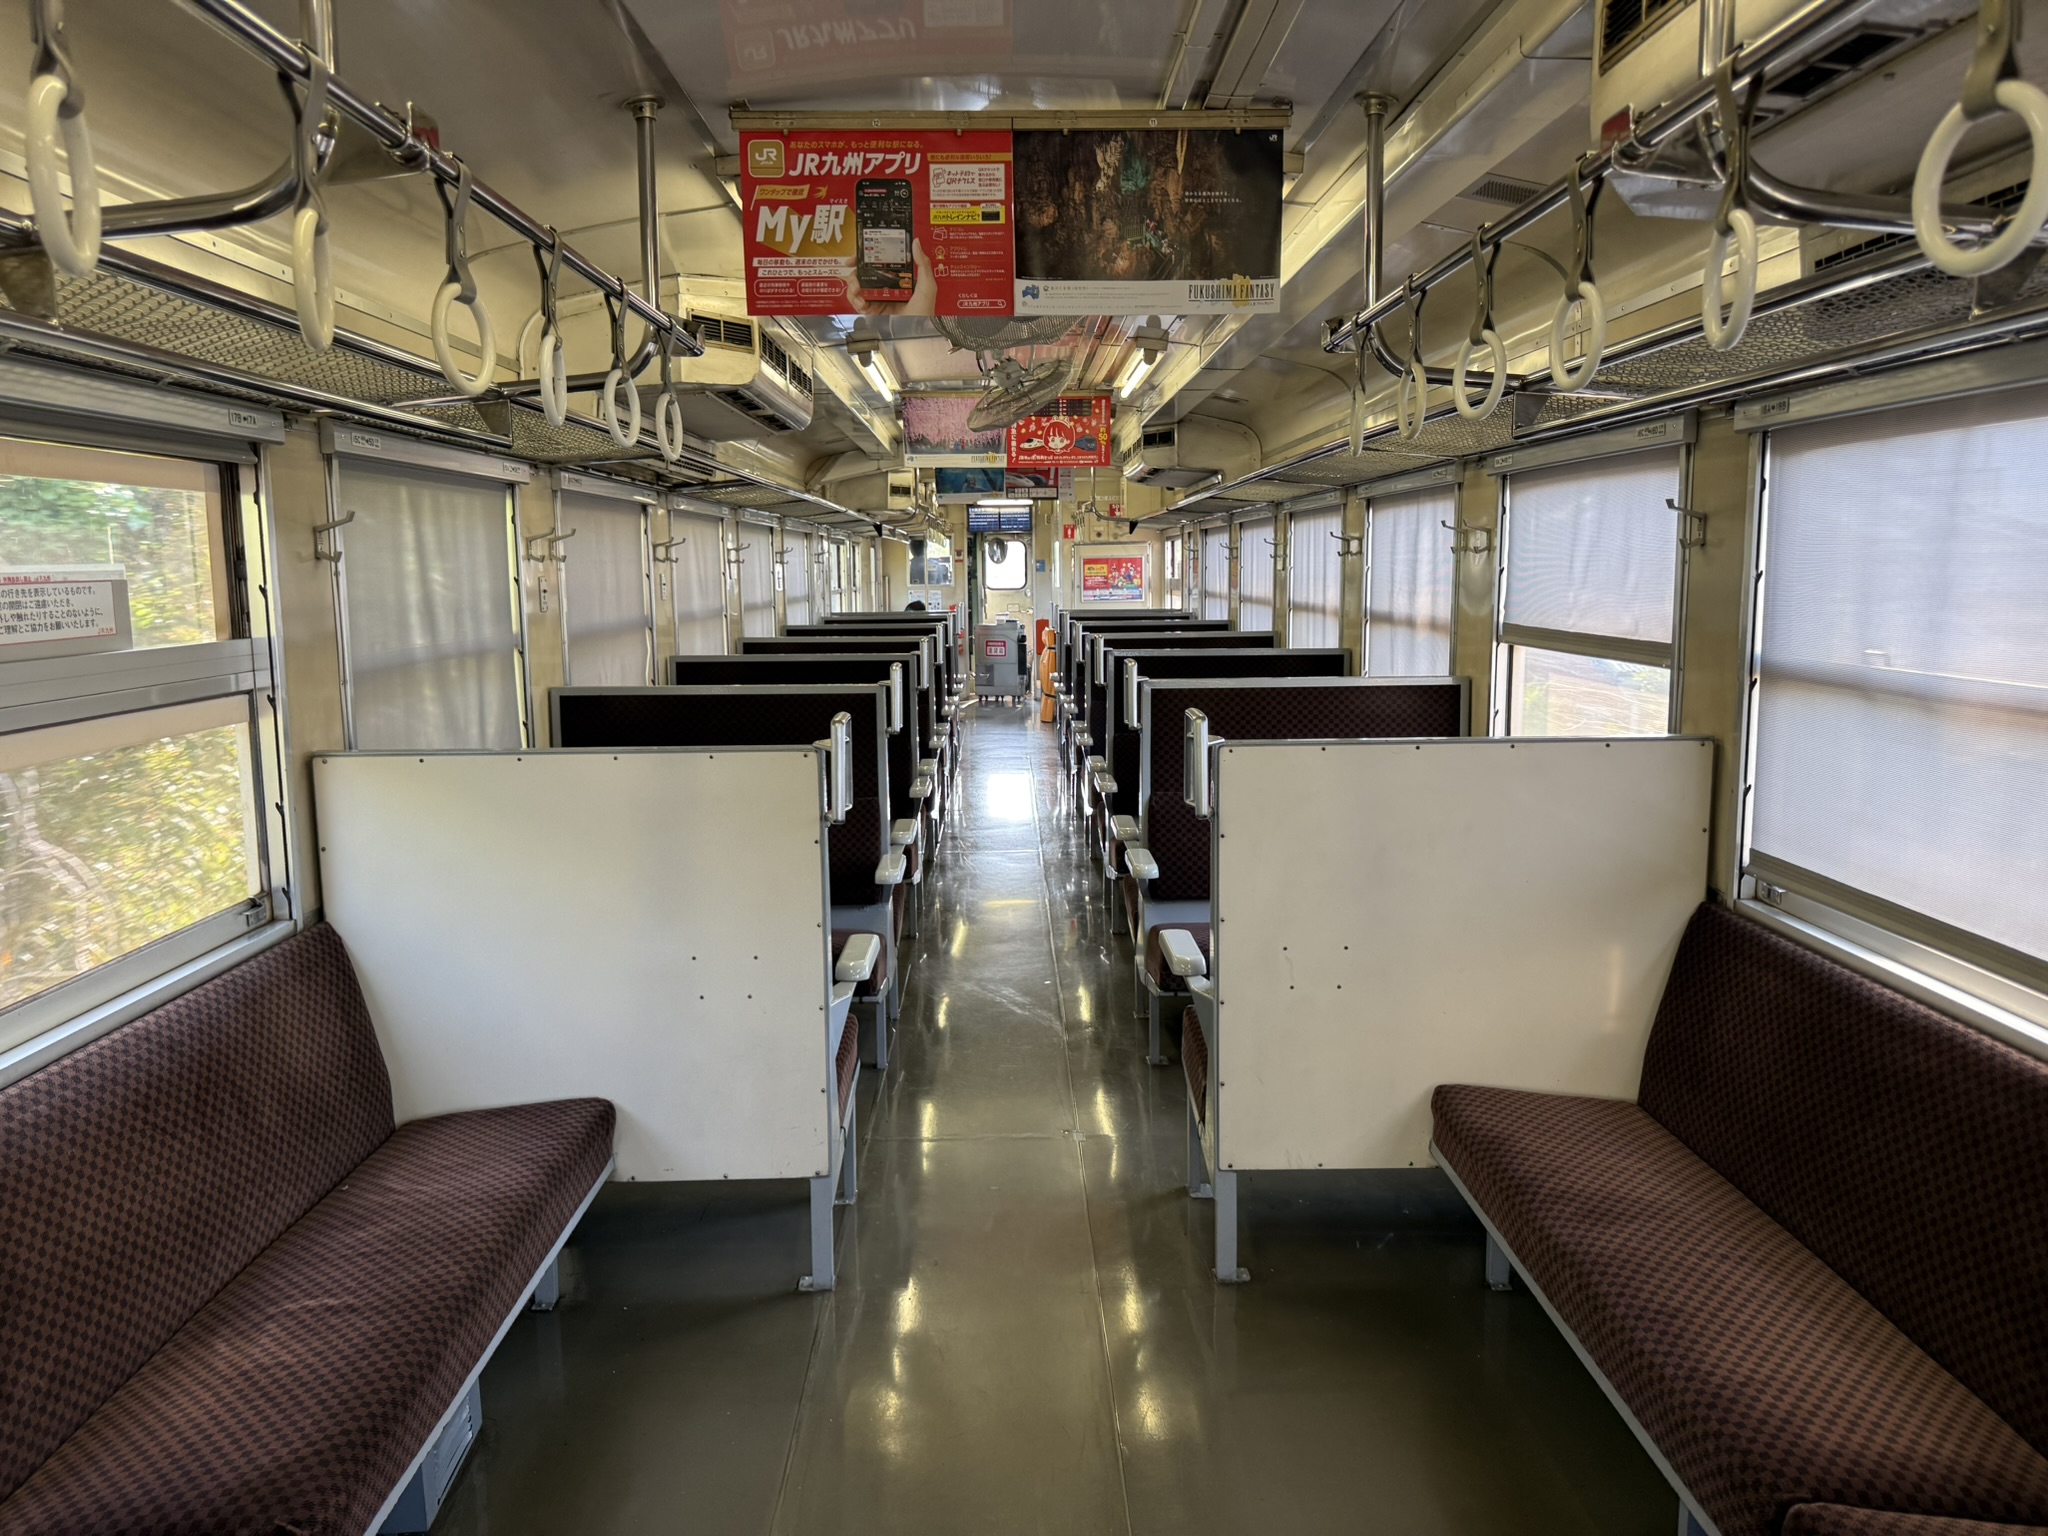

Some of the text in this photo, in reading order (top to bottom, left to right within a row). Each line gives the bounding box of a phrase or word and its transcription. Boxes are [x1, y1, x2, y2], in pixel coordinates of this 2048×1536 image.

[755, 148, 777, 161] JR
[788, 151, 921, 176] JR九州アプリ
[1188, 284, 1237, 299] FUKUSHIMA
[1240, 283, 1275, 299] FANTASY
[0, 586, 96, 599] の行き先を表示しているものです。
